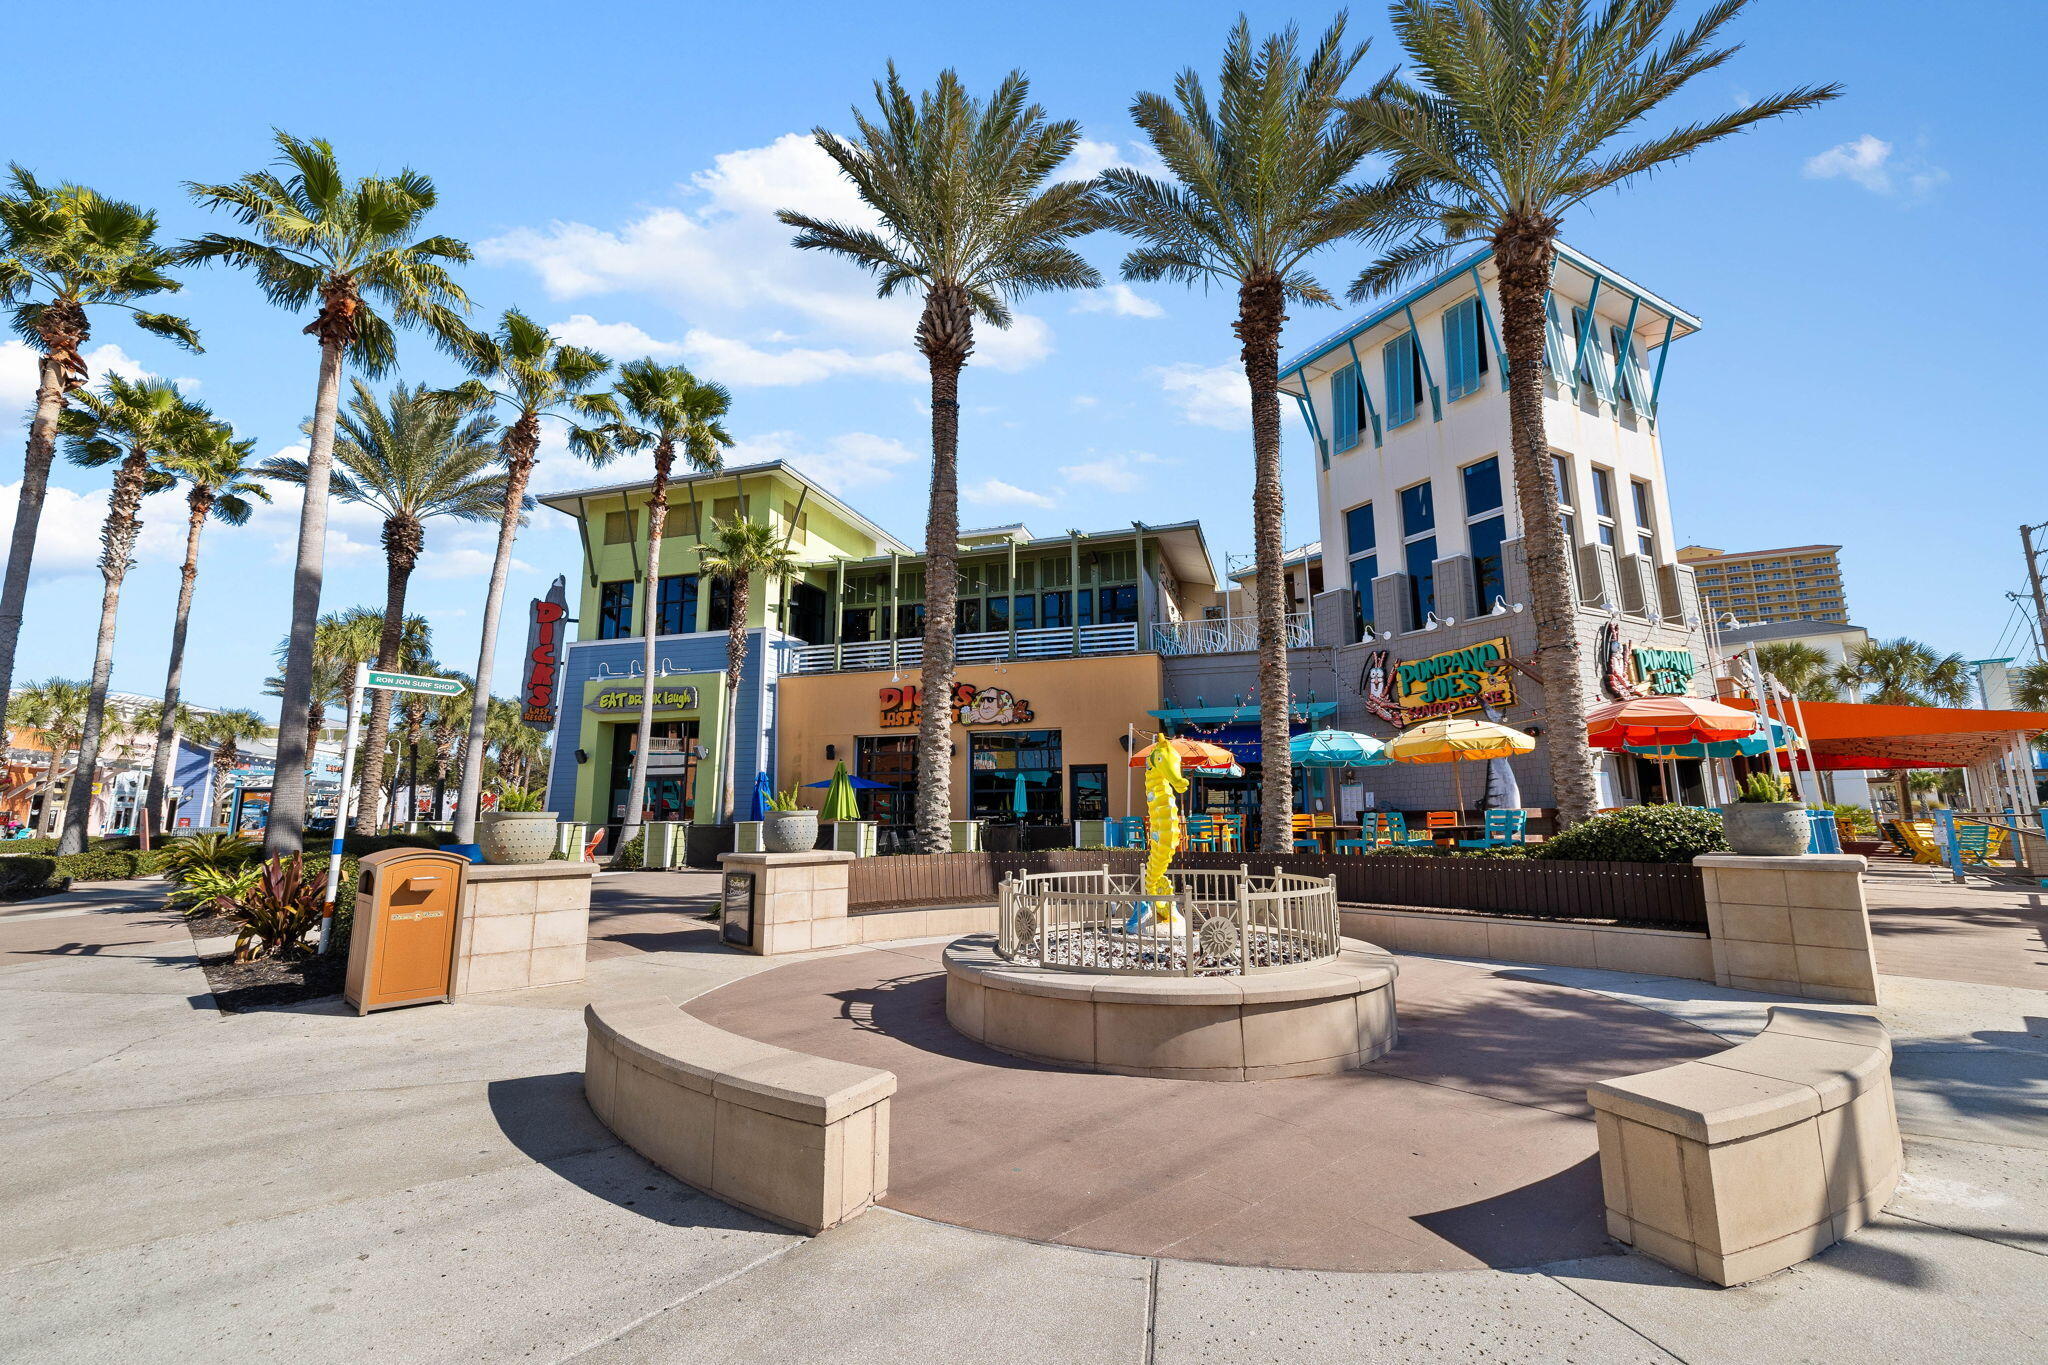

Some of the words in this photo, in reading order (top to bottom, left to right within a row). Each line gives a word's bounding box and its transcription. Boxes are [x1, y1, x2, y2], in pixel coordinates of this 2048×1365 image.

[527, 600, 564, 707] DICK'S
[1398, 644, 1499, 697] POMPANO
[1633, 648, 1696, 681] POMPANO
[376, 676, 394, 684] RON
[395, 677, 411, 686] JON
[412, 680, 433, 688] SURF
[434, 683, 455, 691] SHOP
[1420, 672, 1481, 703] JOE'S
[599, 692, 628, 709] EAT
[627, 693, 662, 706] DRK
[664, 689, 691, 709] laugh
[524, 714, 553, 722] RESORT
[529, 707, 550, 715] LAST
[880, 711, 912, 727] LAST
